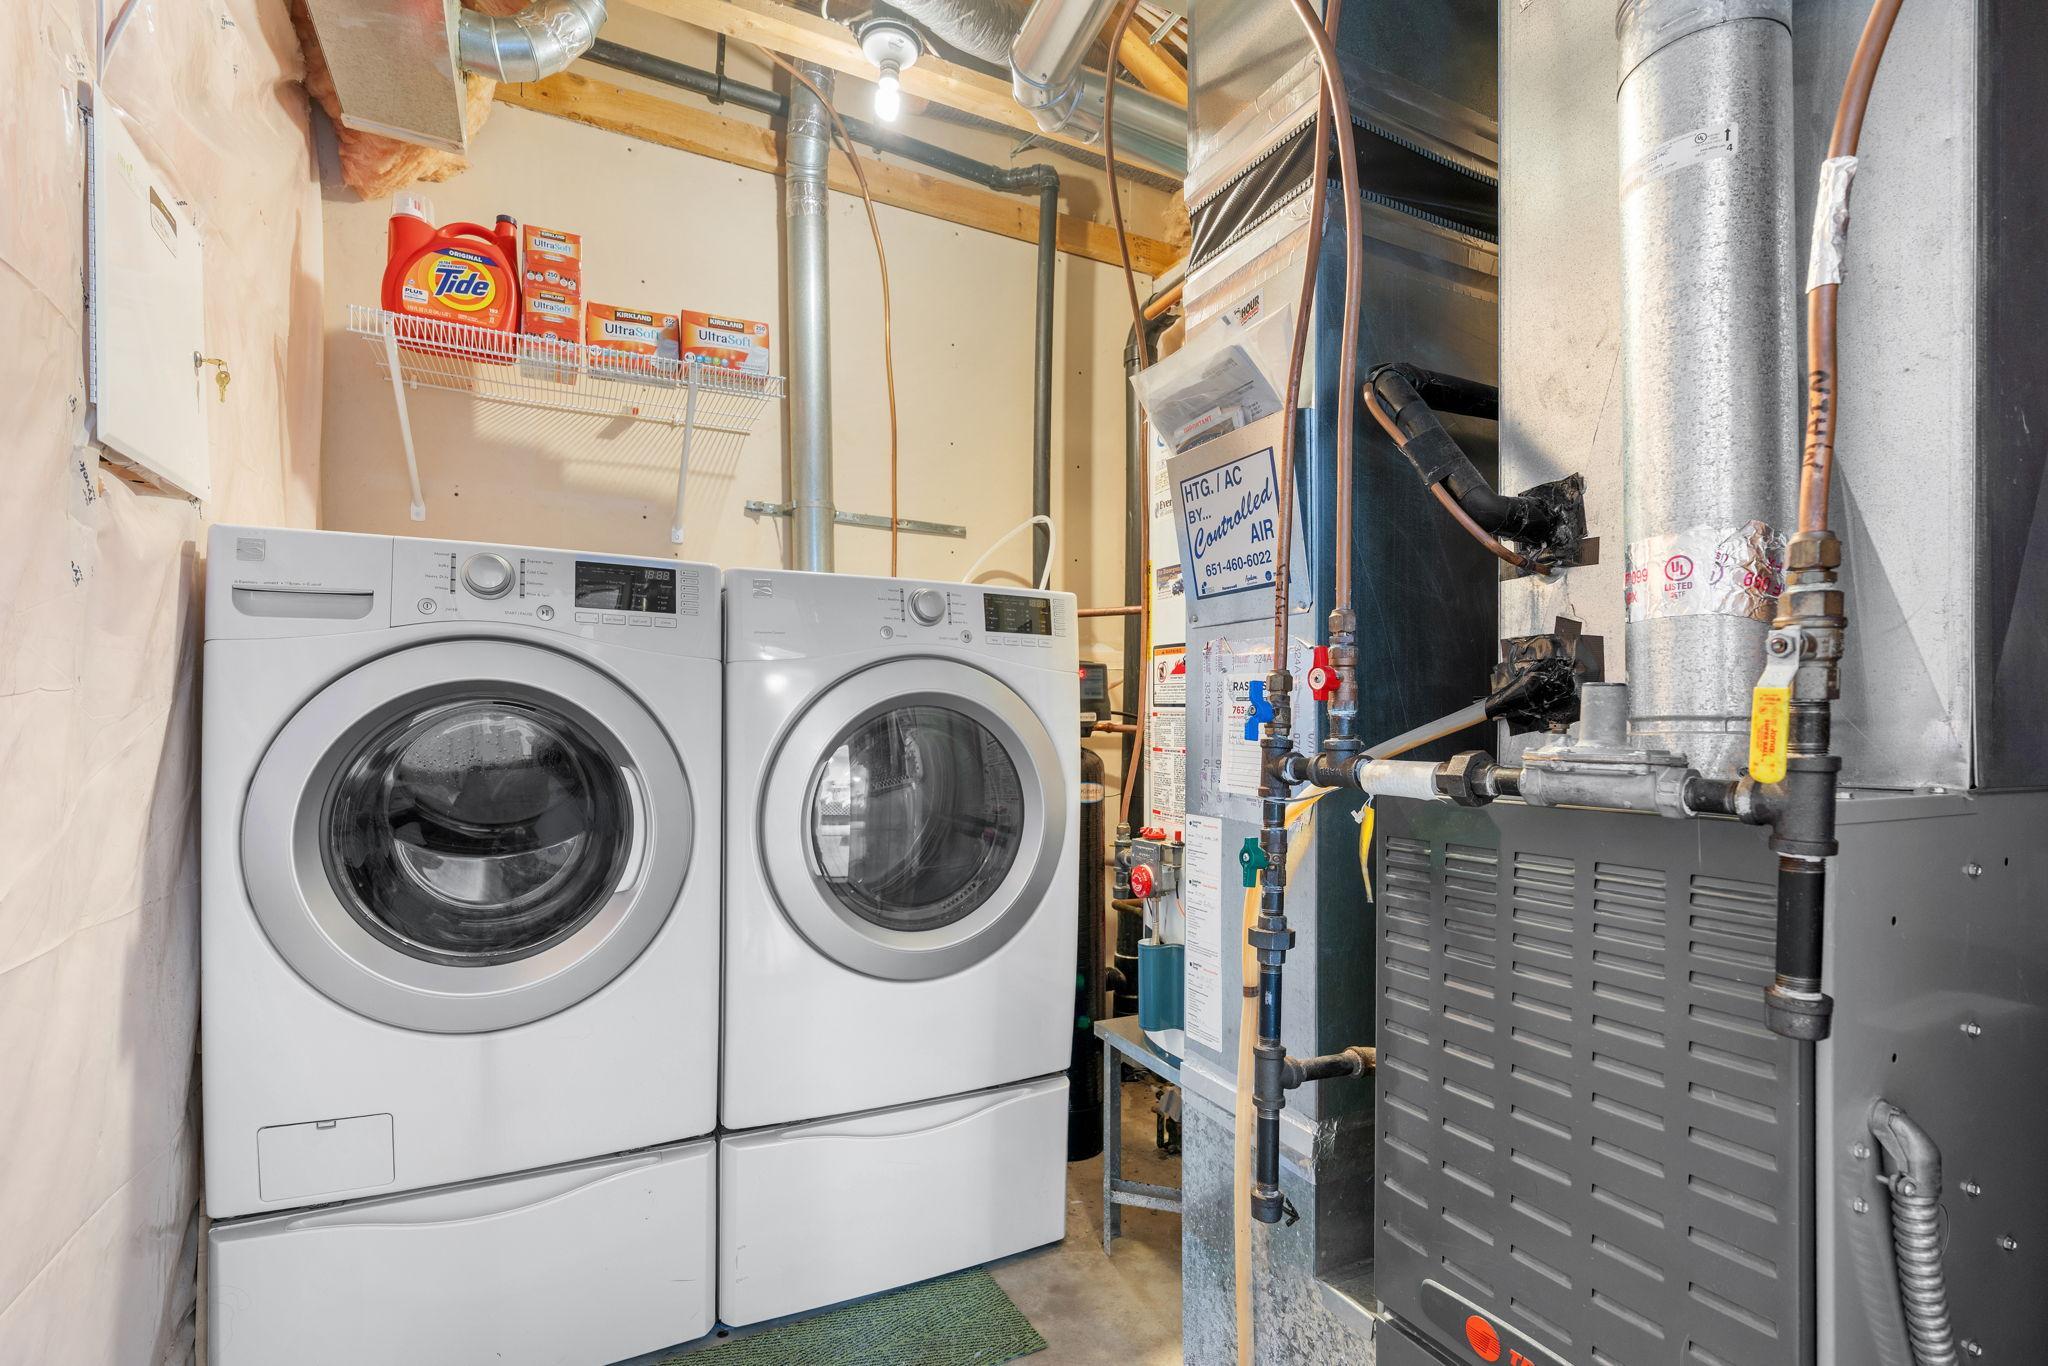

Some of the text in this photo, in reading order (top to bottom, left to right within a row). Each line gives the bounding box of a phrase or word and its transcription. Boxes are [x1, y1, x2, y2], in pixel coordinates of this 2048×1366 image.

[1726, 143, 1733, 151] 4
[534, 239, 572, 253] UltraSoft
[448, 250, 483, 262] ORIGINAL
[434, 267, 490, 298] Tide
[404, 287, 424, 295] PLUS
[533, 301, 571, 313] UltraSoft
[1241, 294, 1260, 318] HOUR
[616, 311, 652, 322] KIRKLAND
[709, 318, 743, 329] KIRKLAND
[604, 322, 660, 340] UltraSoft
[756, 325, 766, 333] 250
[699, 329, 752, 348] UltraSoft
[78, 460, 94, 503] Tyvek
[1184, 465, 1243, 503] HTG. / AC
[1187, 507, 1212, 525] BY...
[1194, 476, 1273, 560] Controlled
[1250, 518, 1275, 544] AIR
[1205, 549, 1273, 577] 651-460-6022
[1671, 561, 1686, 576] UL
[1664, 582, 1693, 591] LISTED
[1253, 654, 1273, 665] 324A
